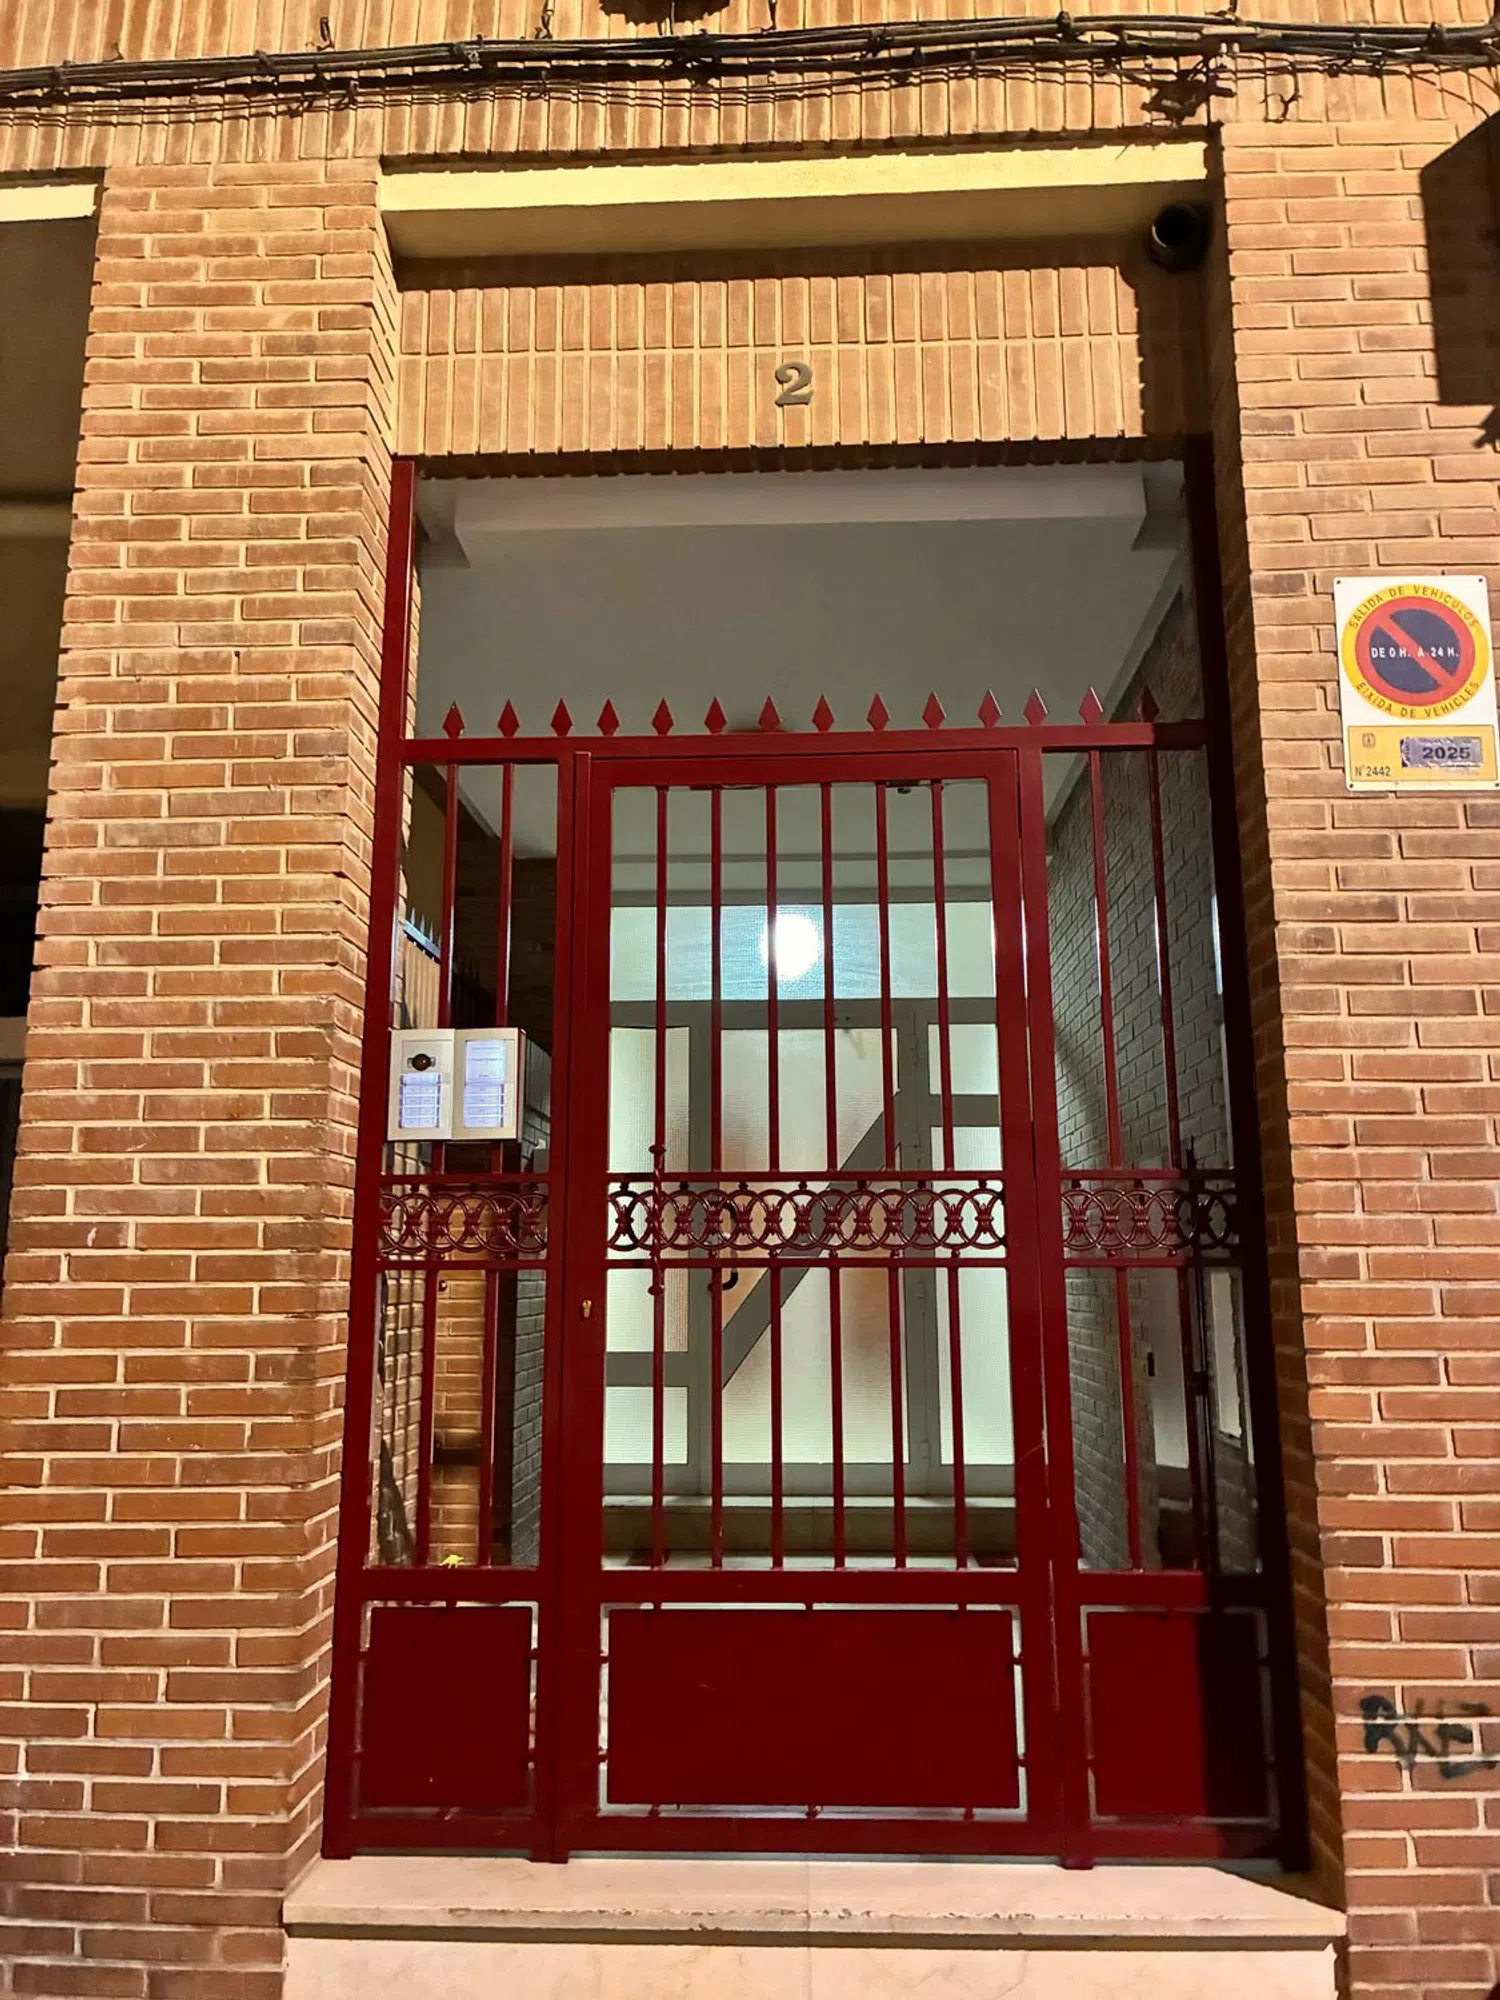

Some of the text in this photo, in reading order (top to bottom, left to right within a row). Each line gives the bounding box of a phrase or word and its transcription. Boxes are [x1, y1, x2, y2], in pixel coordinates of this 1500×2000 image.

[774, 361, 814, 407] 2
[1349, 594, 1383, 628] SALIDA
[1388, 585, 1404, 597] DE
[1371, 647, 1385, 658] DE
[1417, 647, 1424, 658] A
[1430, 647, 1444, 658] 24
[1356, 681, 1479, 718] EIXIDA DE VEHICLES
[1422, 746, 1471, 760] 2025
